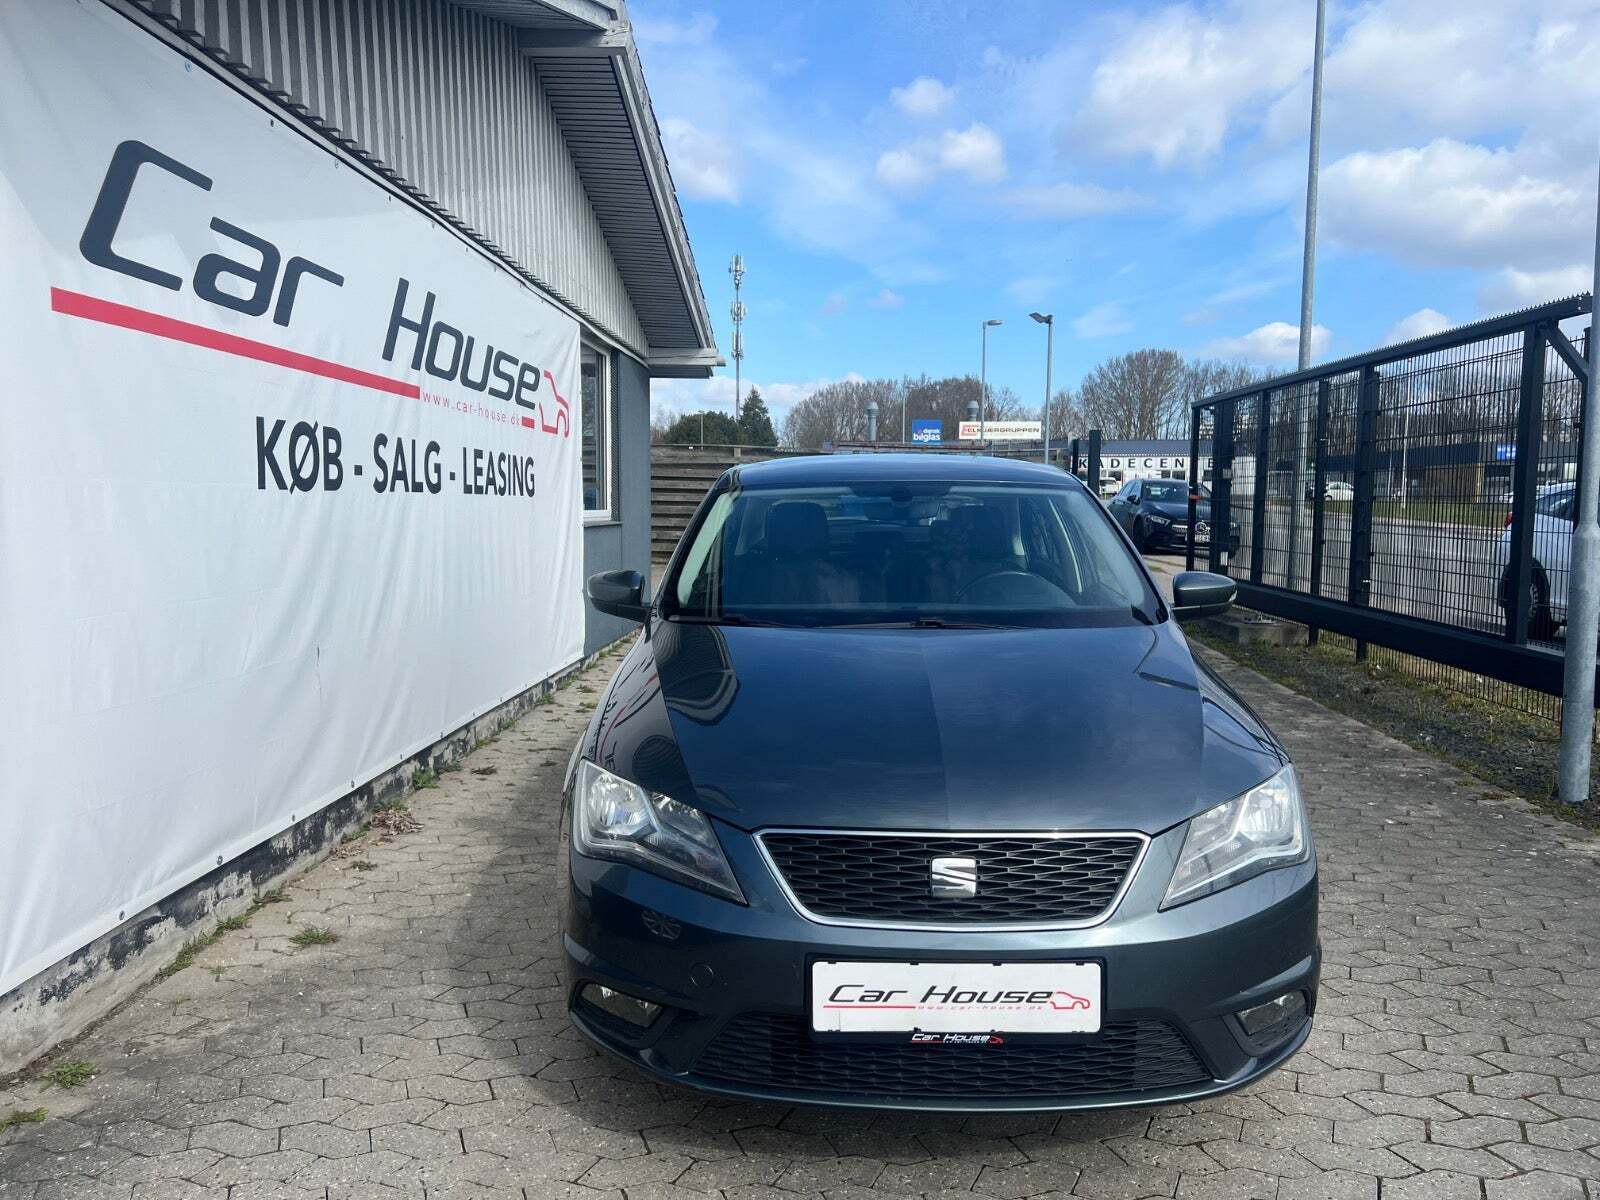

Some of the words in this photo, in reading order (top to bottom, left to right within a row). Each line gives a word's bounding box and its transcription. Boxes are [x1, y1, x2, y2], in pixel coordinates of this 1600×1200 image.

[79, 140, 345, 328] Car
[381, 277, 541, 412] House
[422, 391, 520, 425] www.car-house.dk
[255, 415, 344, 495] KØB
[372, 432, 443, 495] SALG
[462, 446, 536, 498] LEASING
[828, 984, 909, 1003] Car
[919, 985, 1053, 1004] House
[911, 1033, 940, 1041] Car
[942, 1033, 990, 1042] House
